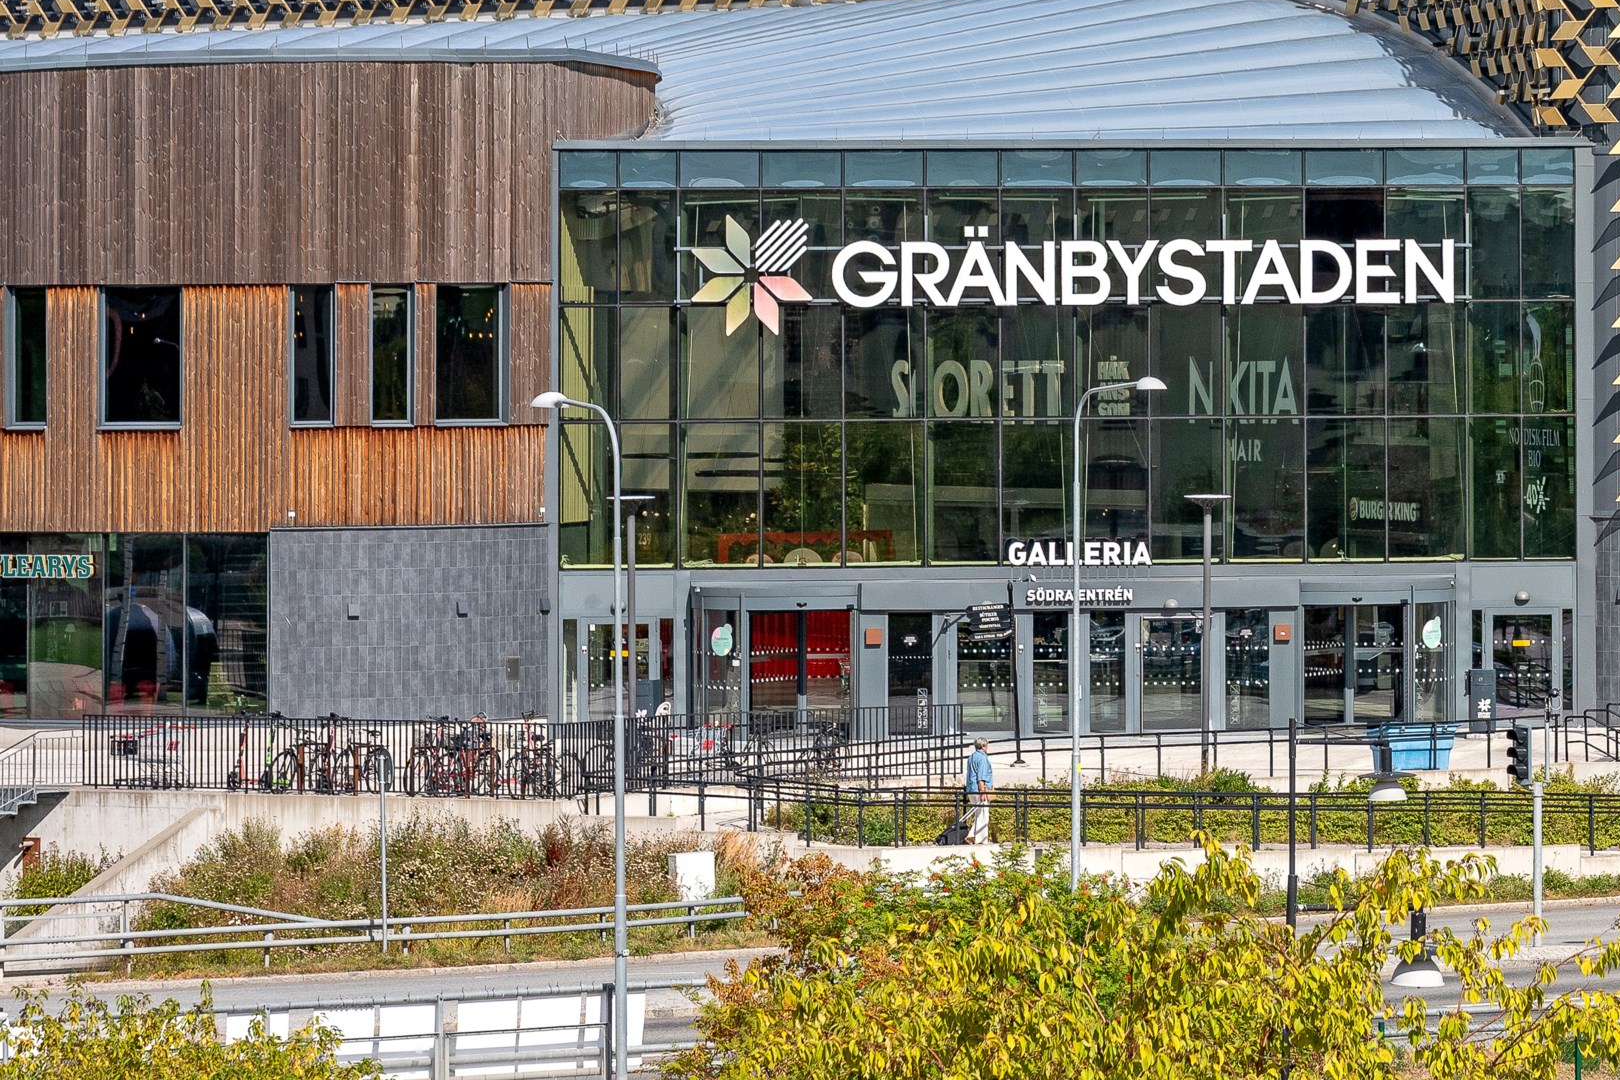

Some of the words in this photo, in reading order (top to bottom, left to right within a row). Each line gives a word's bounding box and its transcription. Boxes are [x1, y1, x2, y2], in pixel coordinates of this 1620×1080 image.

[831, 225, 1455, 308] GRÄNBYSTADEN
[892, 359, 1064, 425] SORETT
[1188, 356, 1300, 425] NKITA
[1509, 428, 1540, 446] NODISK
[1542, 429, 1560, 446] FILM
[1528, 450, 1541, 467] BIO
[1360, 500, 1393, 520] BURGR
[1395, 502, 1417, 521] KING
[1008, 541, 1152, 566] GALLERIA
[0, 554, 94, 579] LEARYS
[1027, 587, 1074, 602] SÖDRA
[1079, 585, 1133, 602] ENTRÉN
